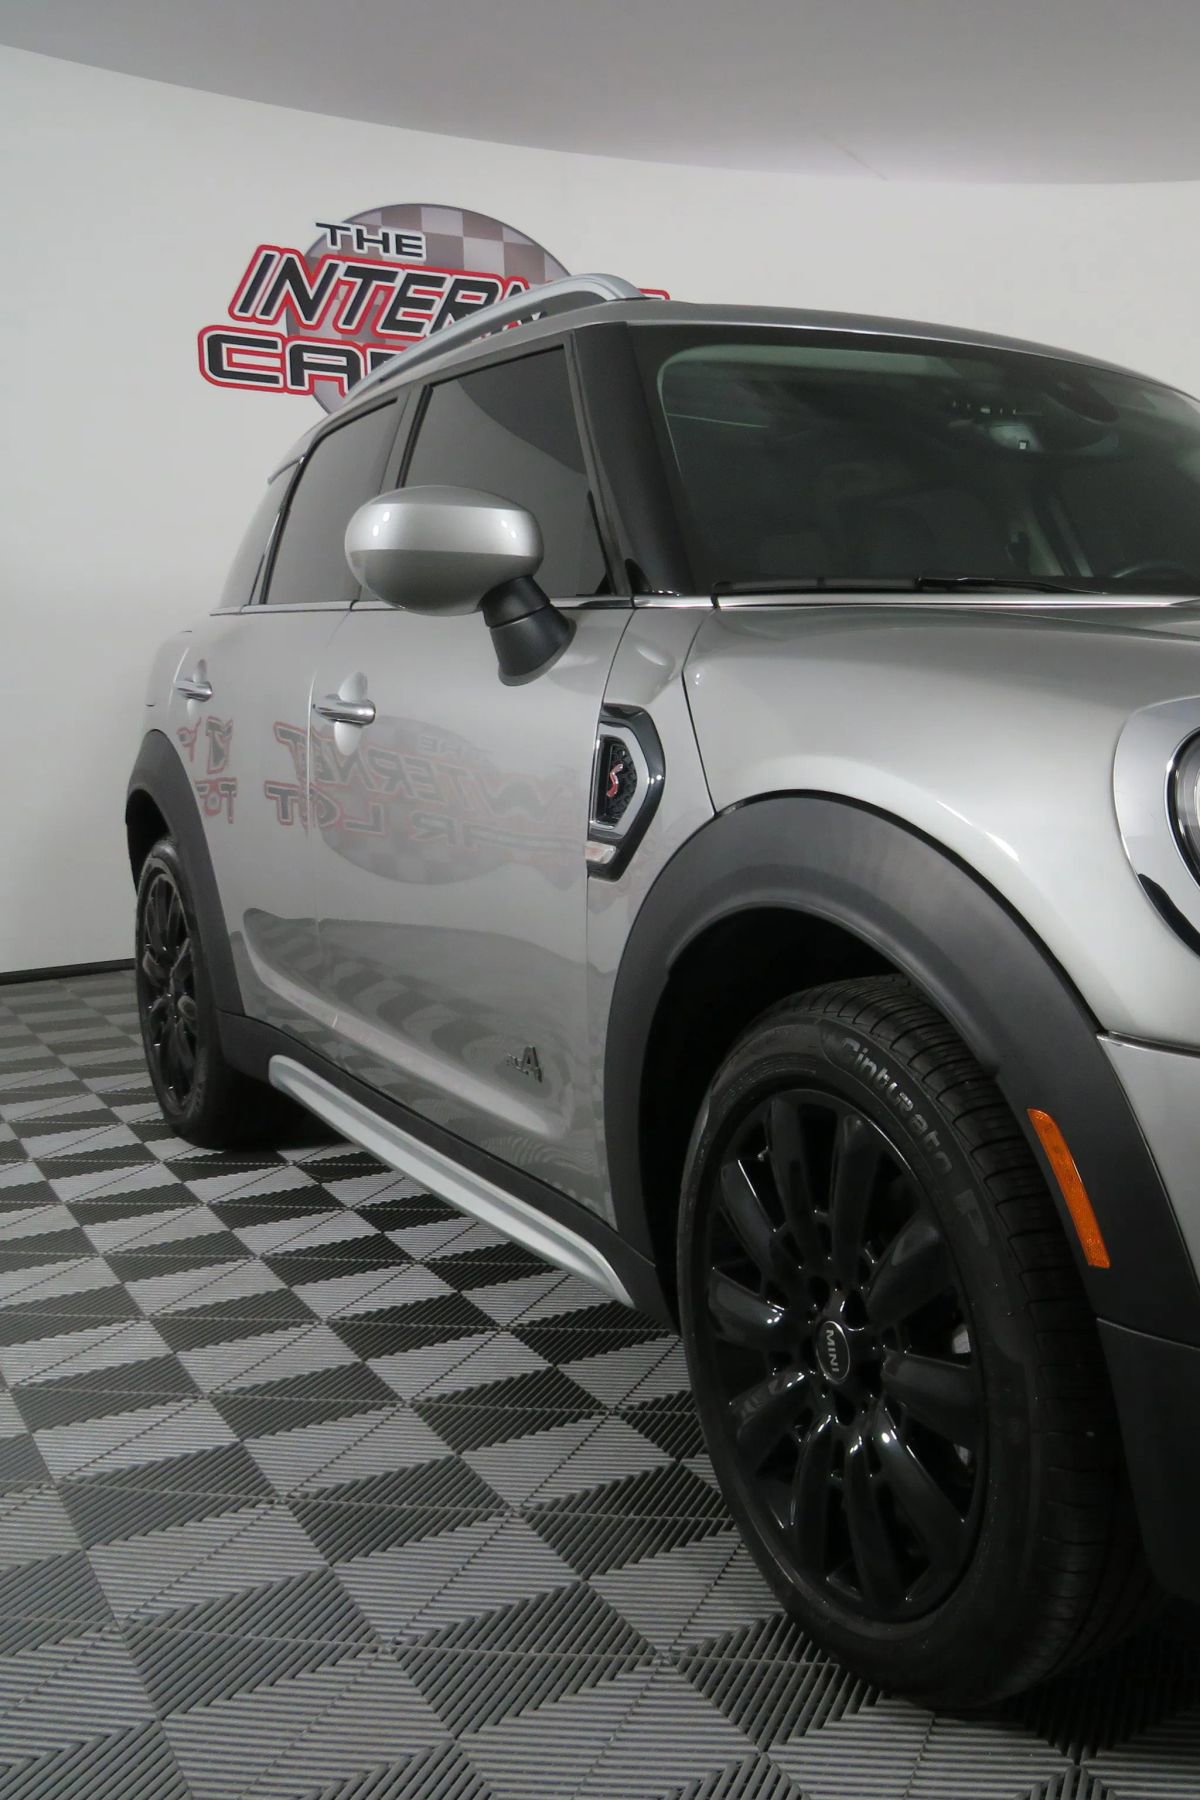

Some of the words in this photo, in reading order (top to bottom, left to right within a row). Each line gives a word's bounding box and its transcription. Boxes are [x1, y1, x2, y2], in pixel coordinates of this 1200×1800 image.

[315, 221, 426, 259] THE
[229, 245, 560, 342] INTER
[199, 325, 410, 396] CA
[825, 1329, 840, 1372] MINI
